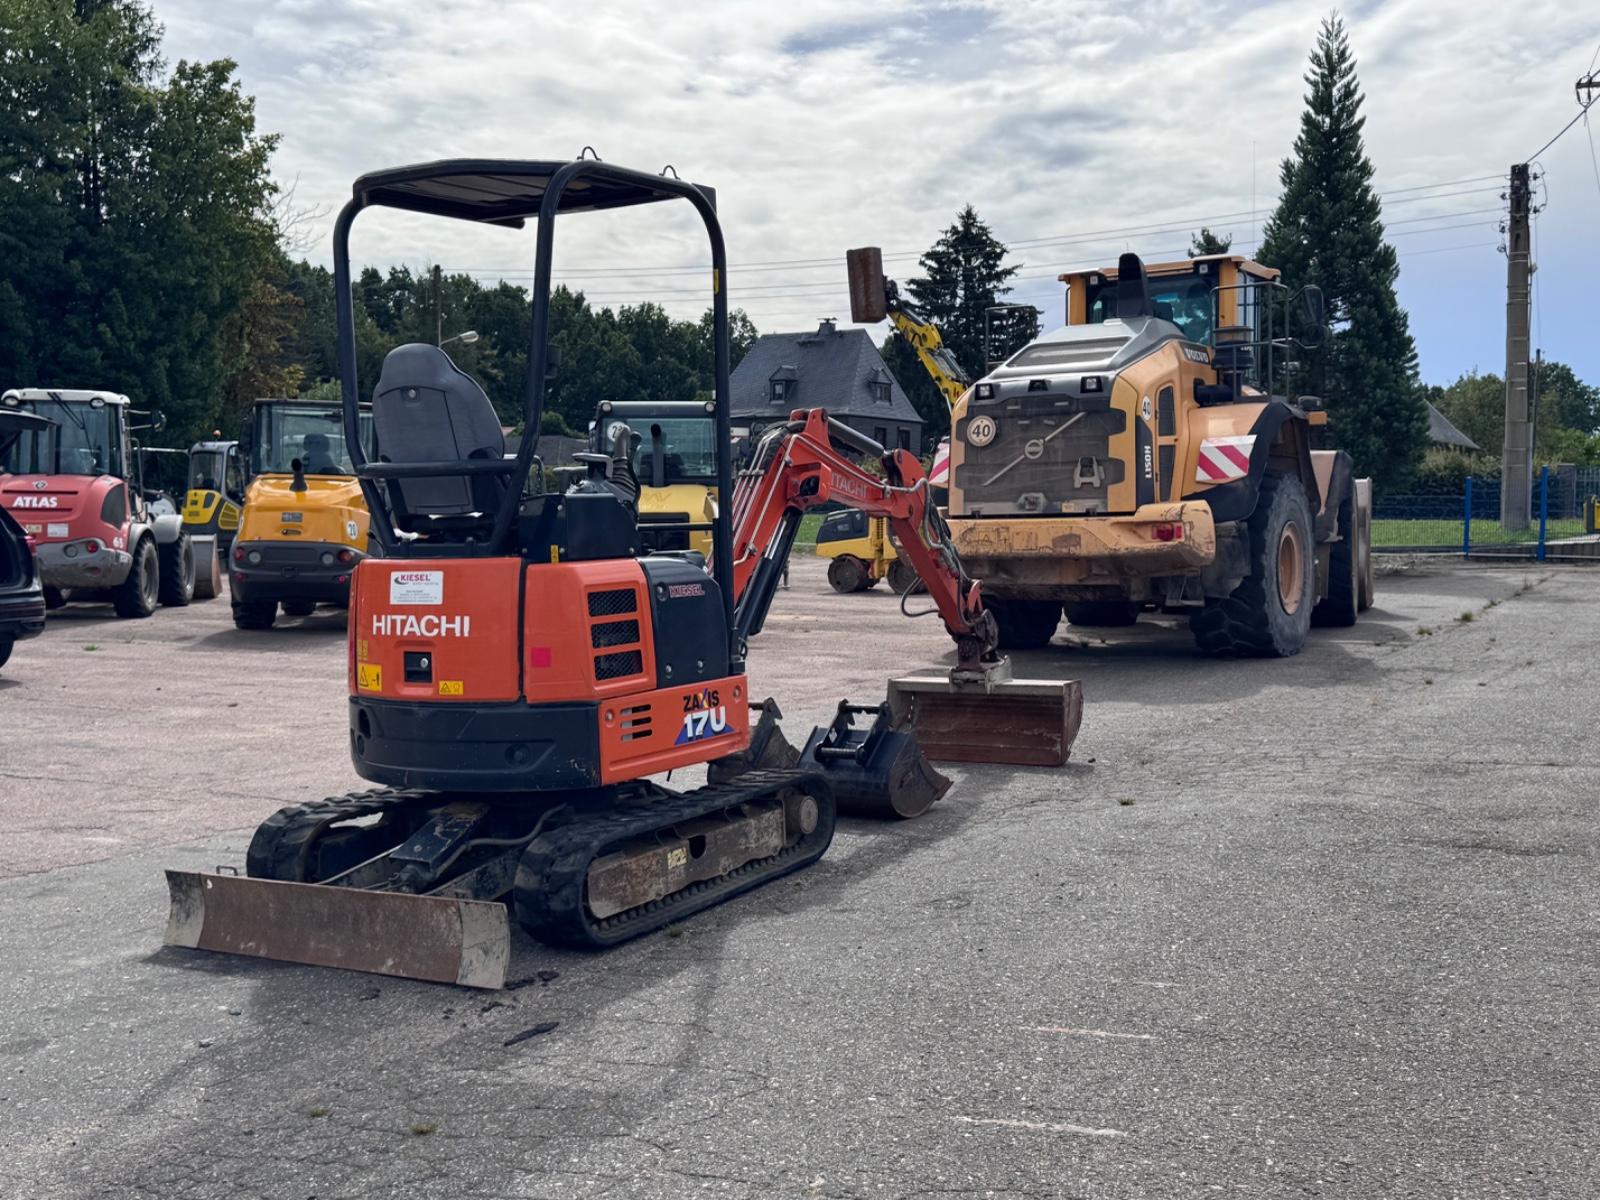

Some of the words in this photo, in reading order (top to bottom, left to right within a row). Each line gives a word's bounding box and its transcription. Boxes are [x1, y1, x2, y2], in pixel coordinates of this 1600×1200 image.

[1184, 348, 1210, 363] VOLVO
[1142, 400, 1151, 416] 40
[972, 424, 991, 438] 40
[1144, 445, 1152, 479] L150H
[831, 471, 867, 499] ITACHI
[12, 496, 58, 508] ATLAS
[400, 573, 431, 582] KIESEL
[668, 583, 706, 598] KIESEL
[372, 614, 470, 637] HITACHI
[683, 688, 720, 712] ZAXIS
[684, 705, 726, 738] 17U
